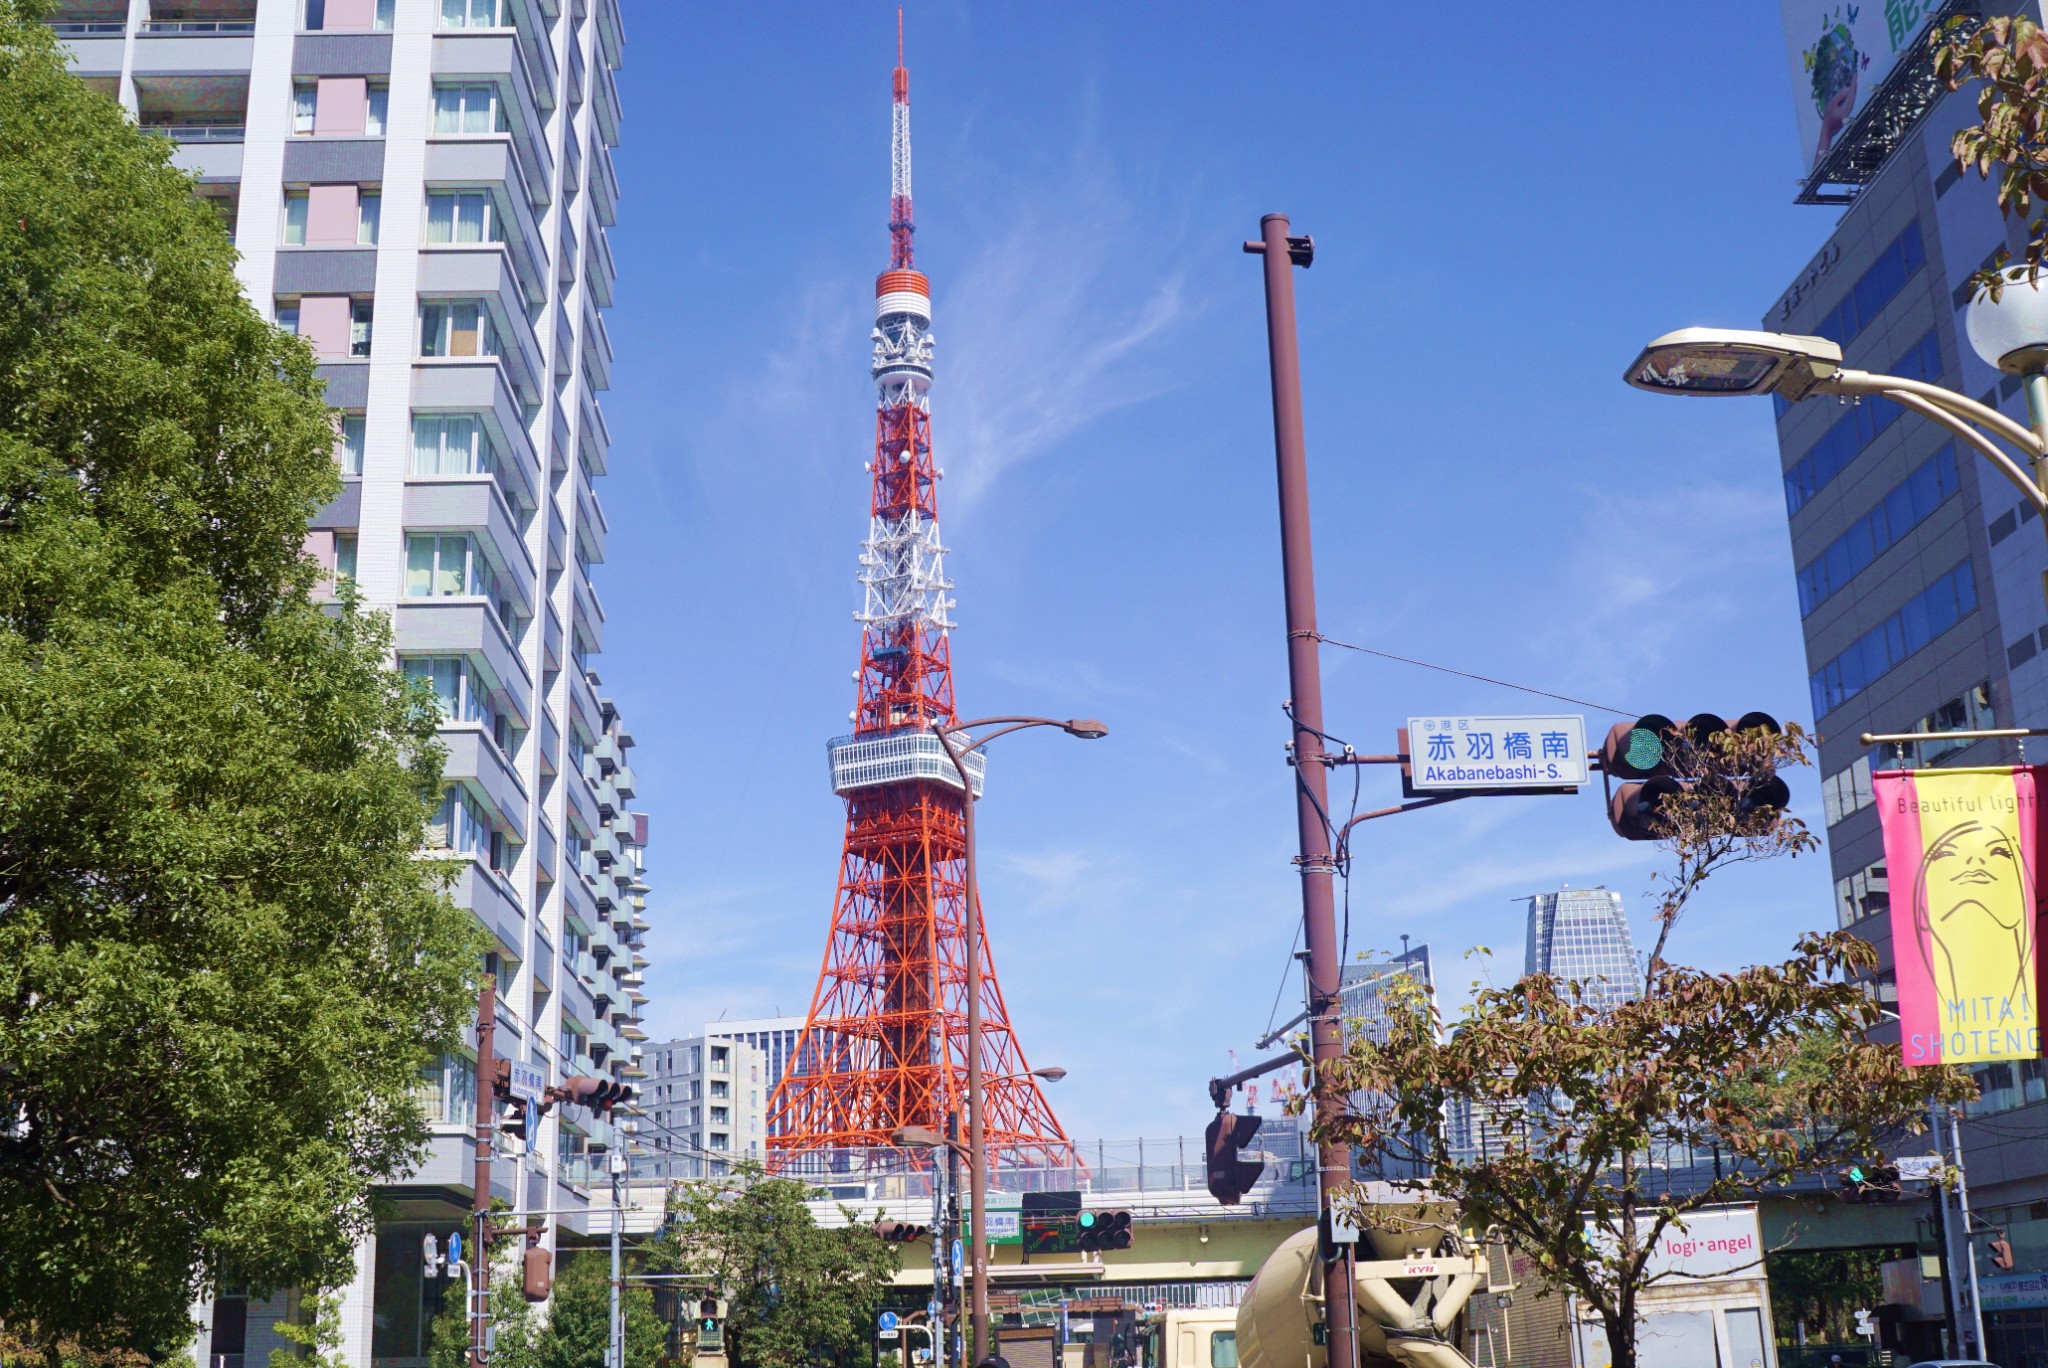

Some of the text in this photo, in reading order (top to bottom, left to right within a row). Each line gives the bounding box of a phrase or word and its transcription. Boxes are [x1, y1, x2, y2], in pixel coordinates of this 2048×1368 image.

[1440, 719, 1470, 731] 港区
[1427, 731, 1569, 761] 赤羽橋南
[1425, 763, 1562, 782] Akabanebashi-S.
[1897, 796, 1983, 814] Beautiful
[1948, 993, 2029, 1023] MITA!
